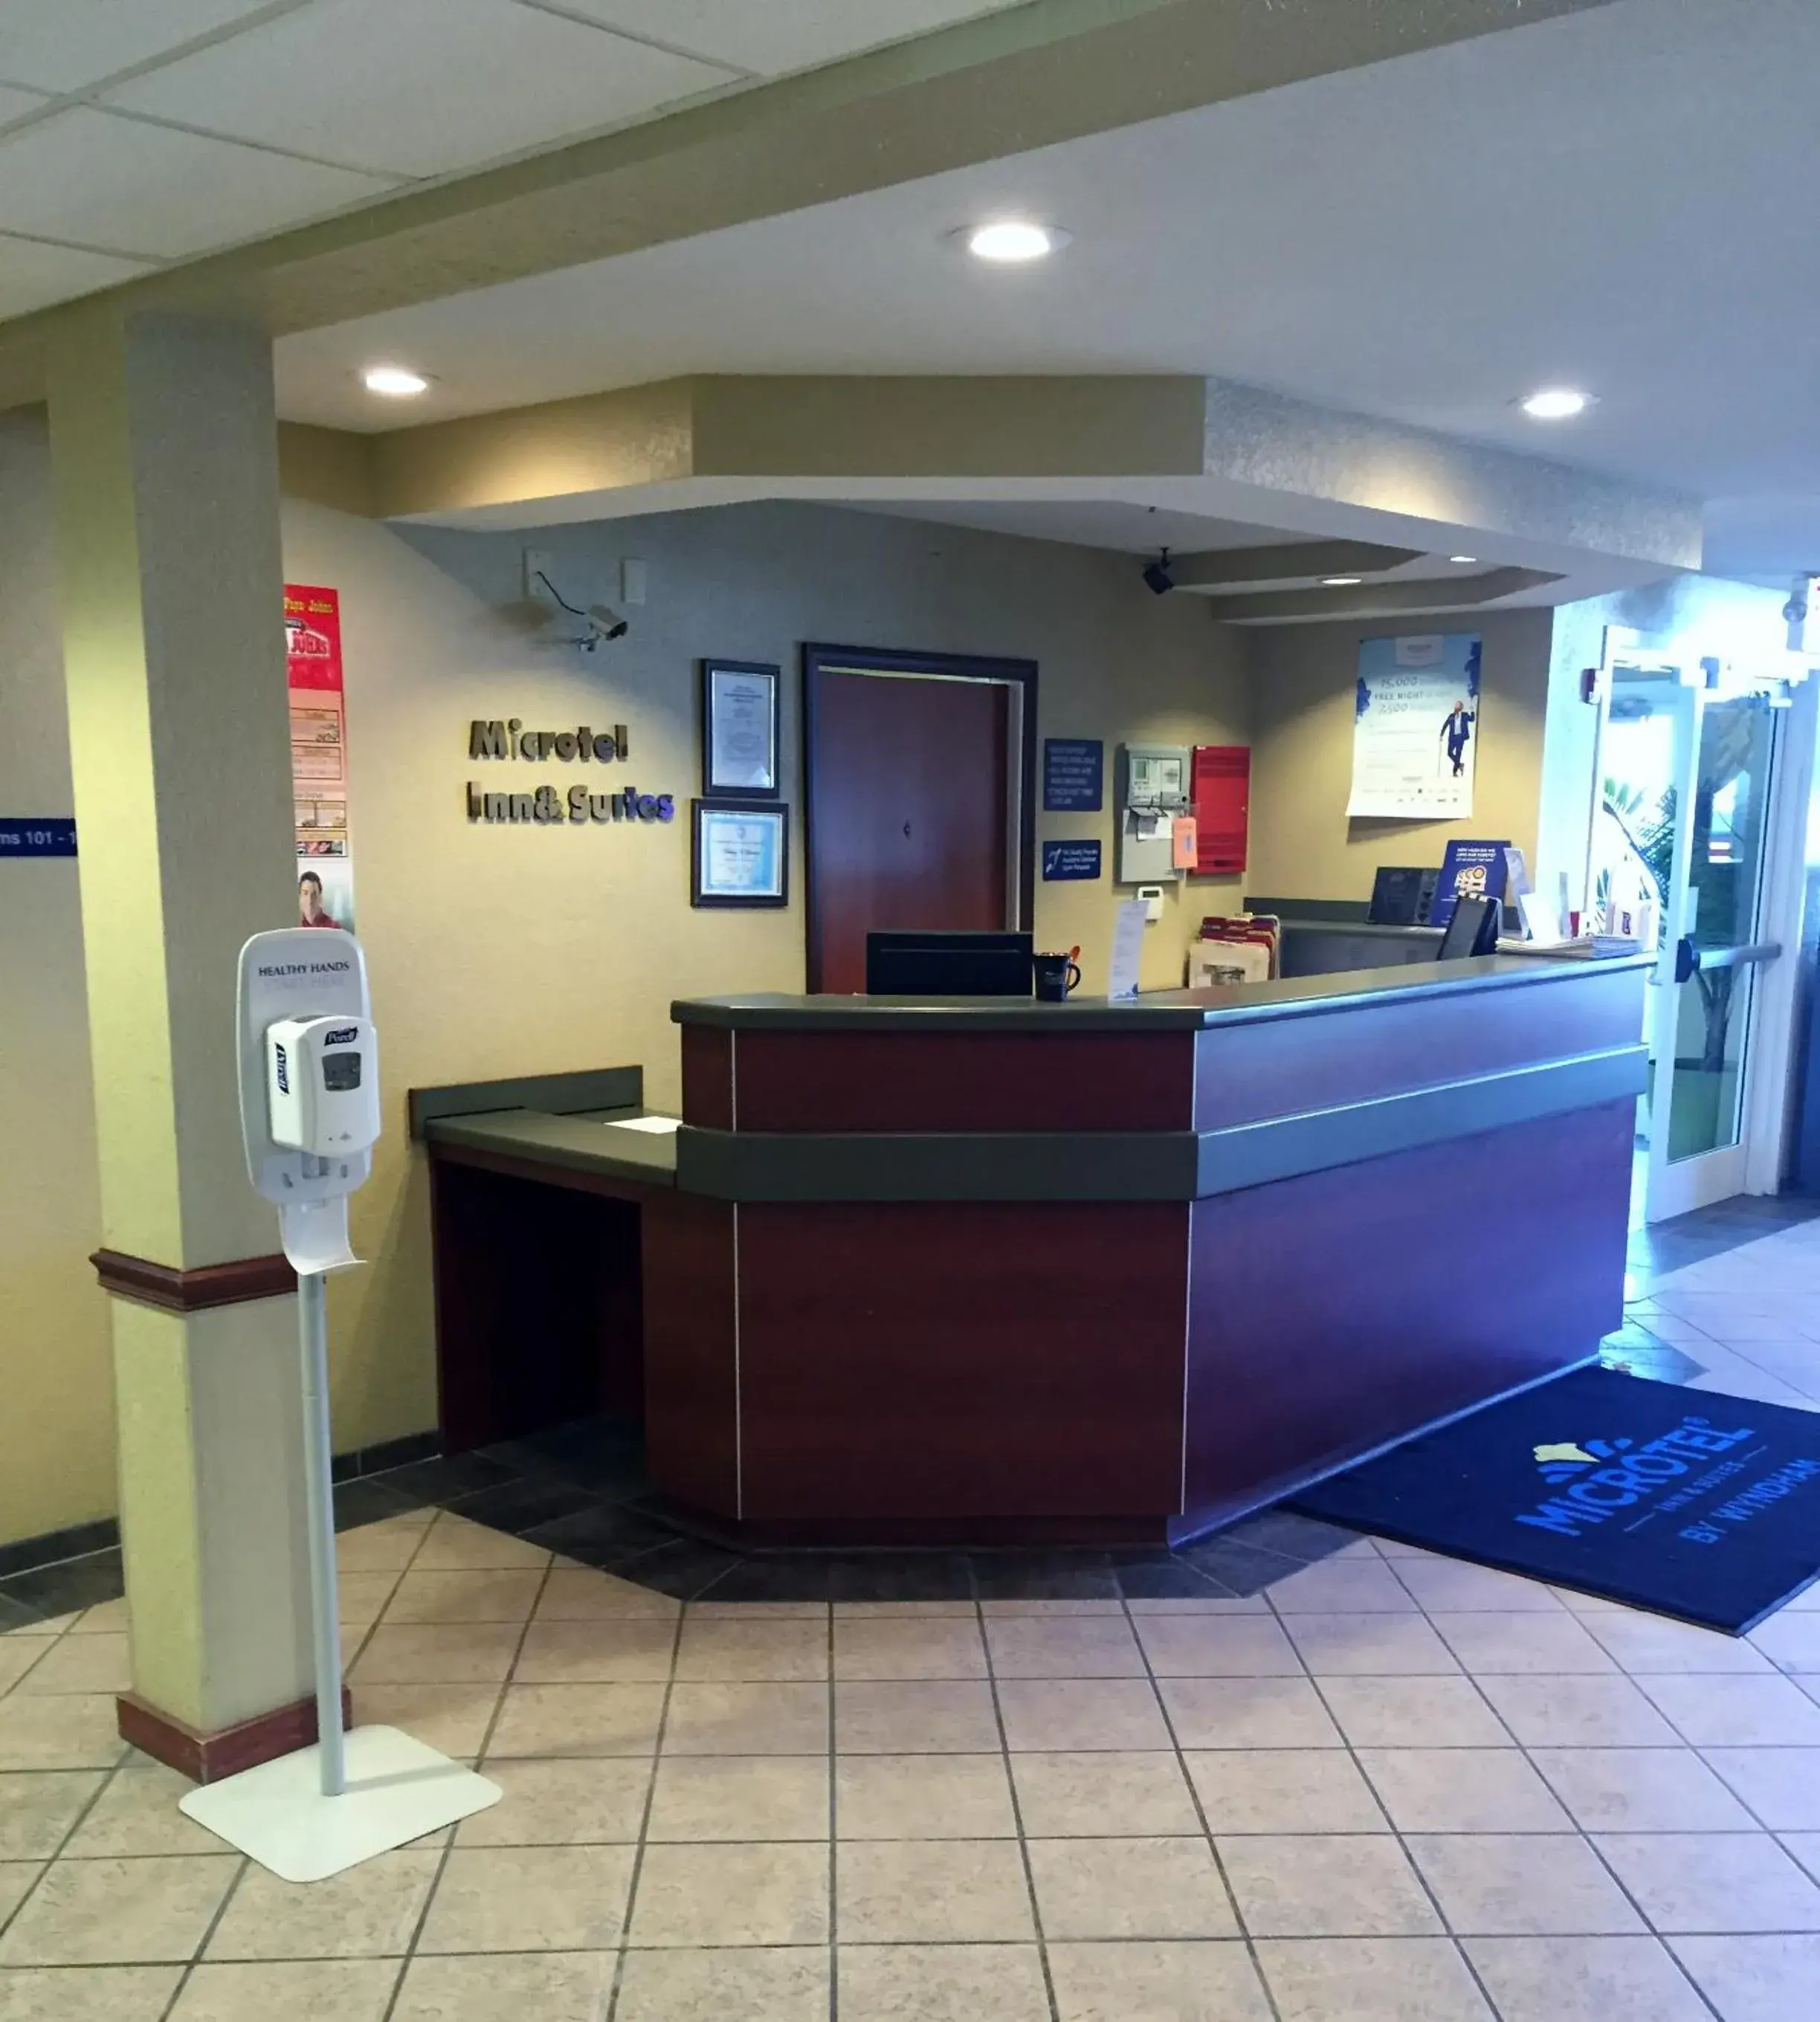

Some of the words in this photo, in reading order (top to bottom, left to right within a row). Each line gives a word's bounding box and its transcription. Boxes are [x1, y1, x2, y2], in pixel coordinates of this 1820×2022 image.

[468, 718, 628, 763] Microtel
[567, 785, 675, 824] Suites
[25, 830, 53, 845] 101
[258, 964, 308, 977] HEALTHY
[310, 960, 350, 973] HANDS
[1514, 1425, 1755, 1537] MICROTEL
[1677, 1519, 1729, 1544] BY
